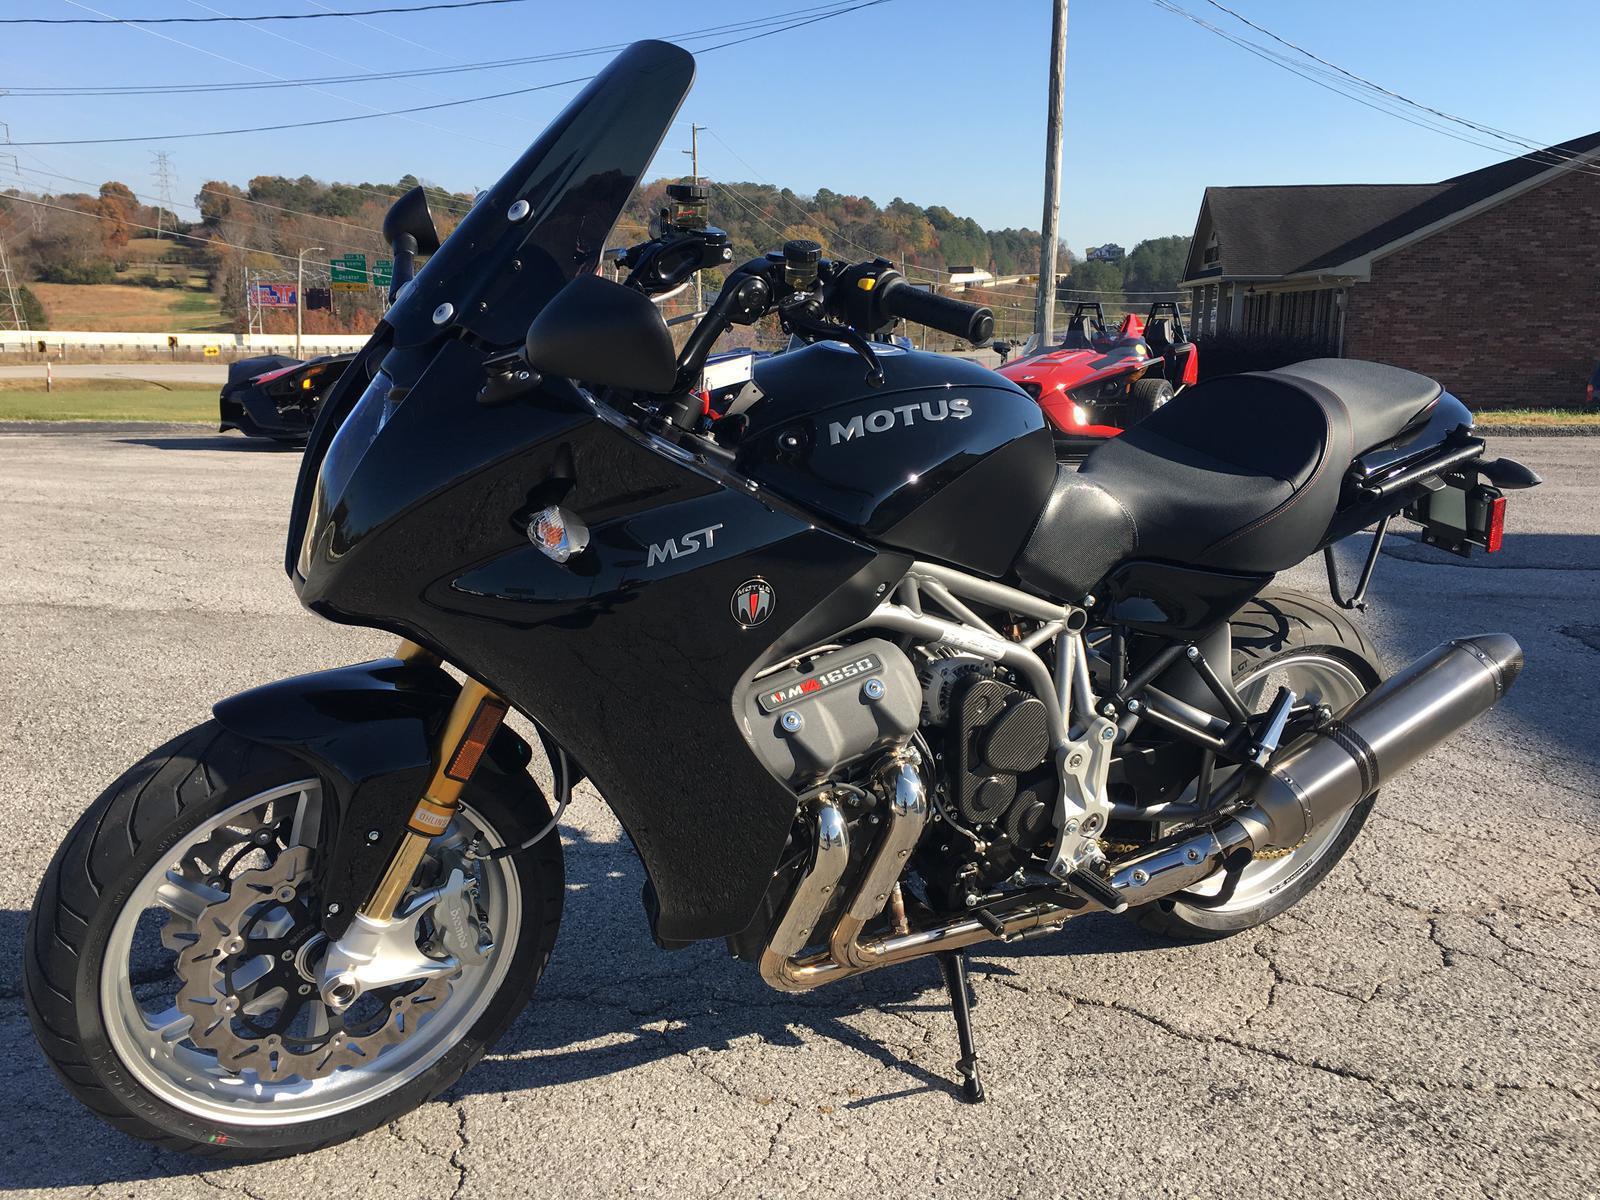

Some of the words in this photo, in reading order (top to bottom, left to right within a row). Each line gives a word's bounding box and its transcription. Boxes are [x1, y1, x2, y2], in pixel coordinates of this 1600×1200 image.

[828, 398, 973, 446] MOTUS
[647, 523, 724, 568] MST
[738, 584, 771, 597] MOTUS
